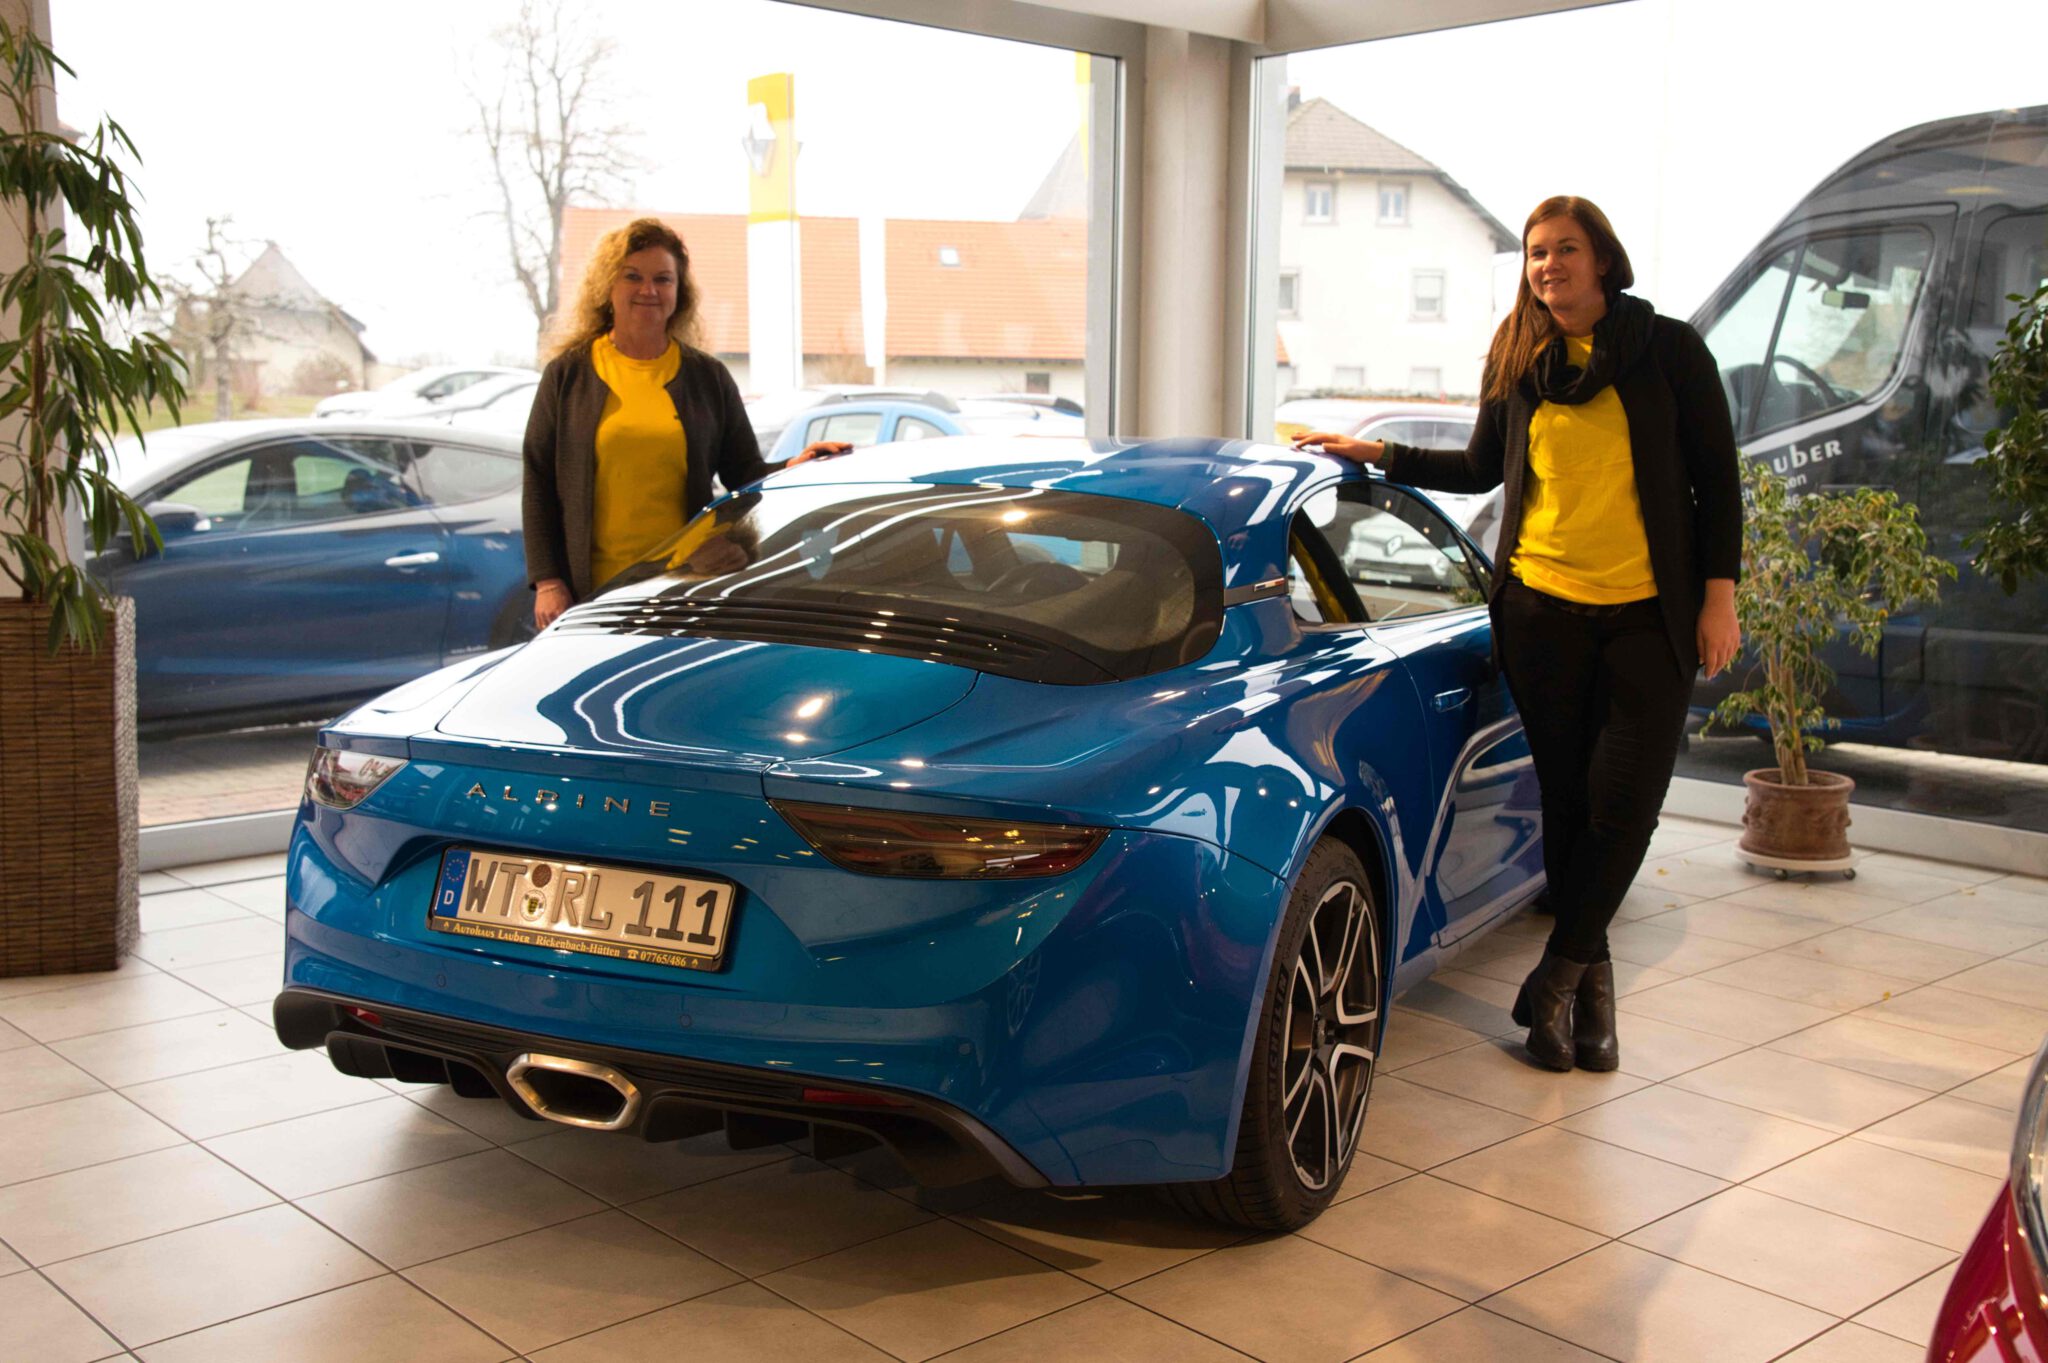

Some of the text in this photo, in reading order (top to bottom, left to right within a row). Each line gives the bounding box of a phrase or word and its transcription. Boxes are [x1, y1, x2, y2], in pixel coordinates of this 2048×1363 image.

[466, 782, 671, 818] ALPINE
[443, 890, 455, 905] D
[465, 859, 719, 947] WT RL 111
[536, 936, 621, 957] Rickenbach-Hütten
[640, 950, 687, 967] 07765/486
[1268, 971, 1288, 1099] MICHELIN
